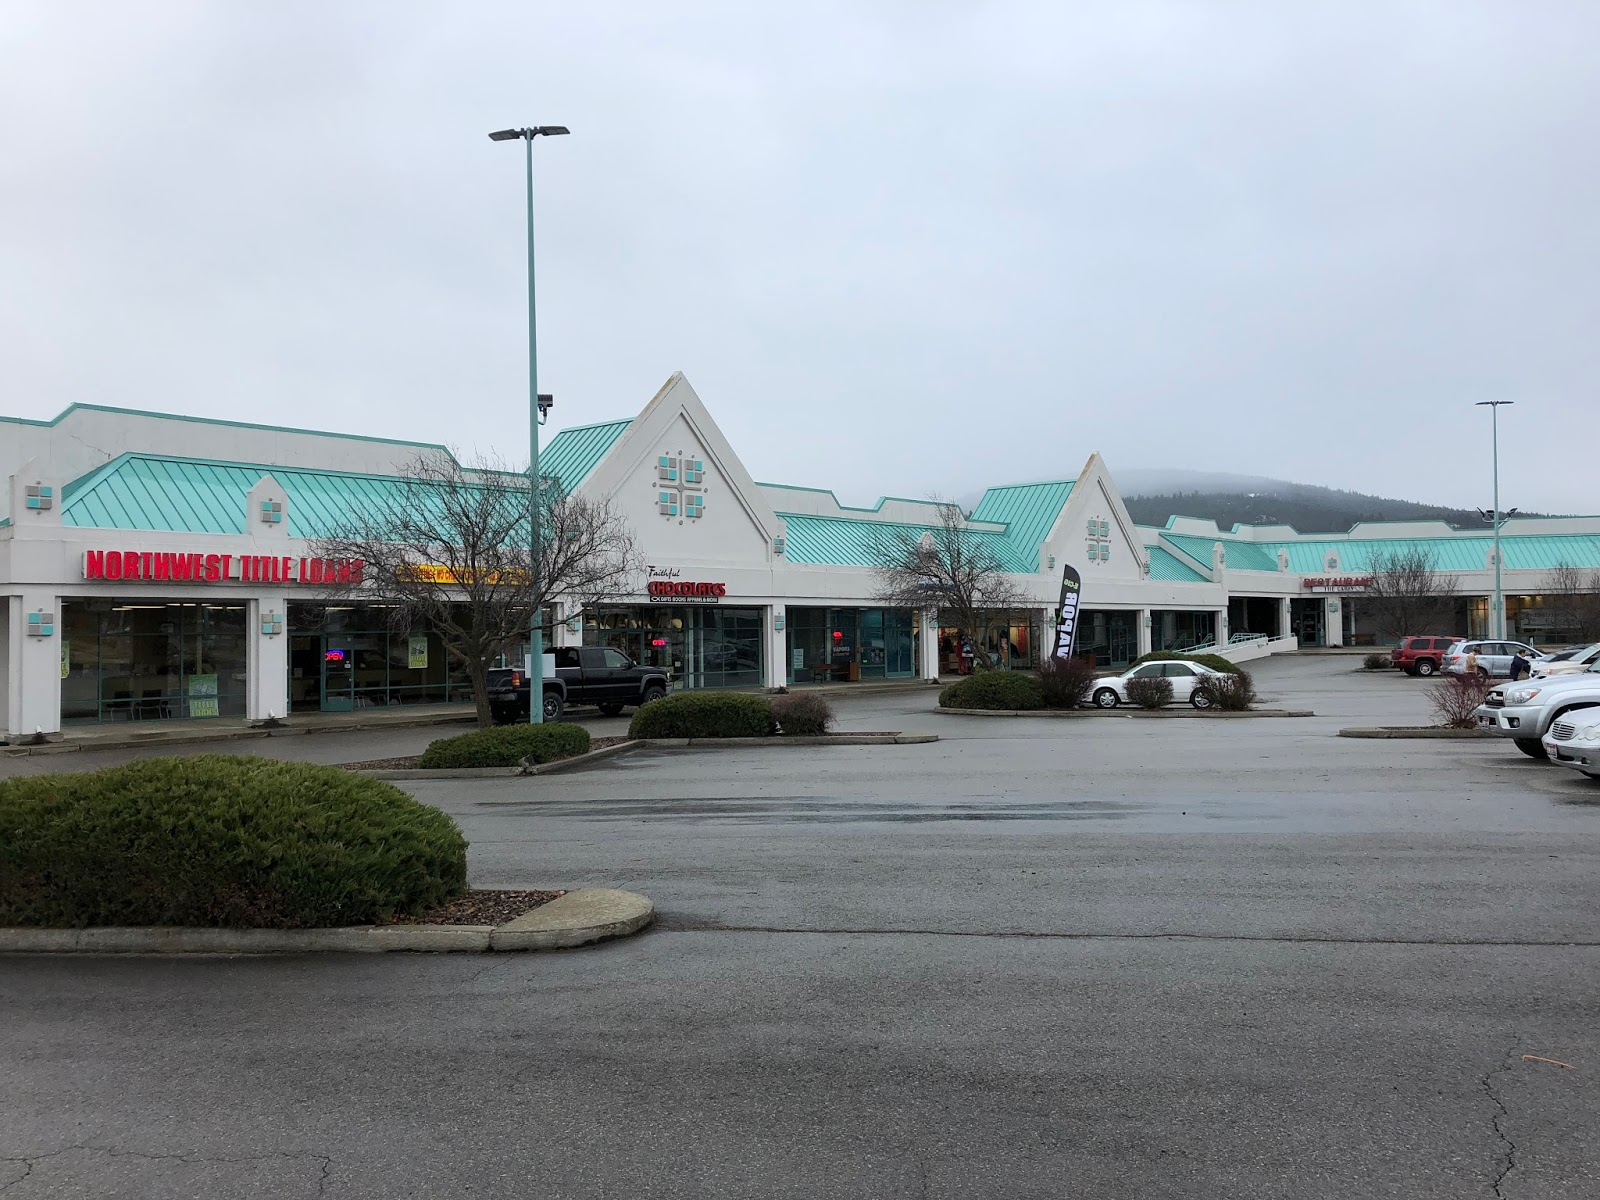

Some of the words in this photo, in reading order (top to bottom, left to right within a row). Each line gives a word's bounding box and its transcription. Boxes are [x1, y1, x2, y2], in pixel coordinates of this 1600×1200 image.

[87, 550, 232, 581] NORTHWEST
[240, 556, 291, 582] TITLE
[299, 558, 364, 584] LOANS
[648, 566, 680, 579] Faithful
[1304, 578, 1373, 587] RESTAURANT
[648, 581, 725, 597] CHOCOLATES
[193, 700, 215, 708] TITLE
[191, 708, 217, 717] LOANS
